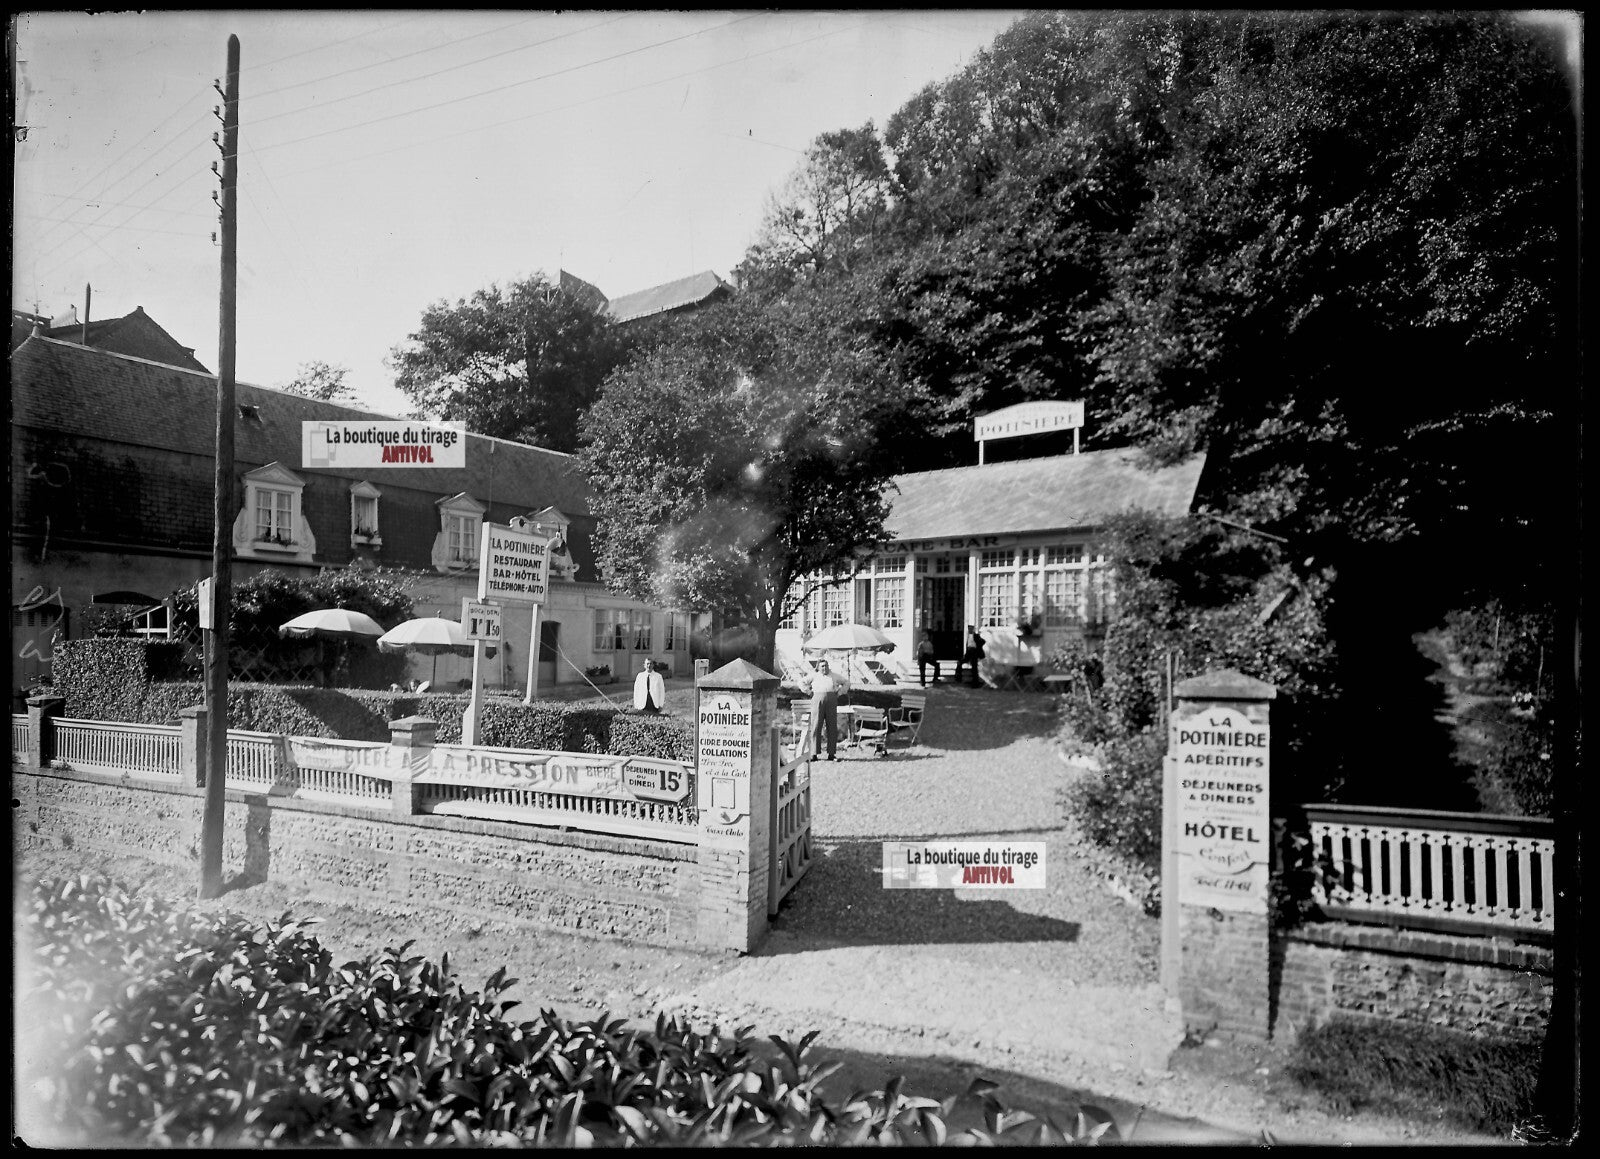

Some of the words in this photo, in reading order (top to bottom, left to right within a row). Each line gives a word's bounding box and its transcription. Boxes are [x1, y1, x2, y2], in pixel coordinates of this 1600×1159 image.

[492, 537, 503, 550] LA
[950, 536, 999, 549] BAR
[494, 554, 542, 569] RESTAURANT
[718, 702, 731, 711] LA
[700, 711, 749, 726] POTINIÈRE
[1210, 717, 1231, 727] LA
[700, 738, 721, 747] CIDRE
[1180, 730, 1266, 748] POTINIÈRE
[701, 748, 748, 758] COLLATIONS
[466, 754, 579, 785] PRESSION
[1184, 821, 1260, 843] HÔTEL
[1199, 847, 1250, 868] Confort
